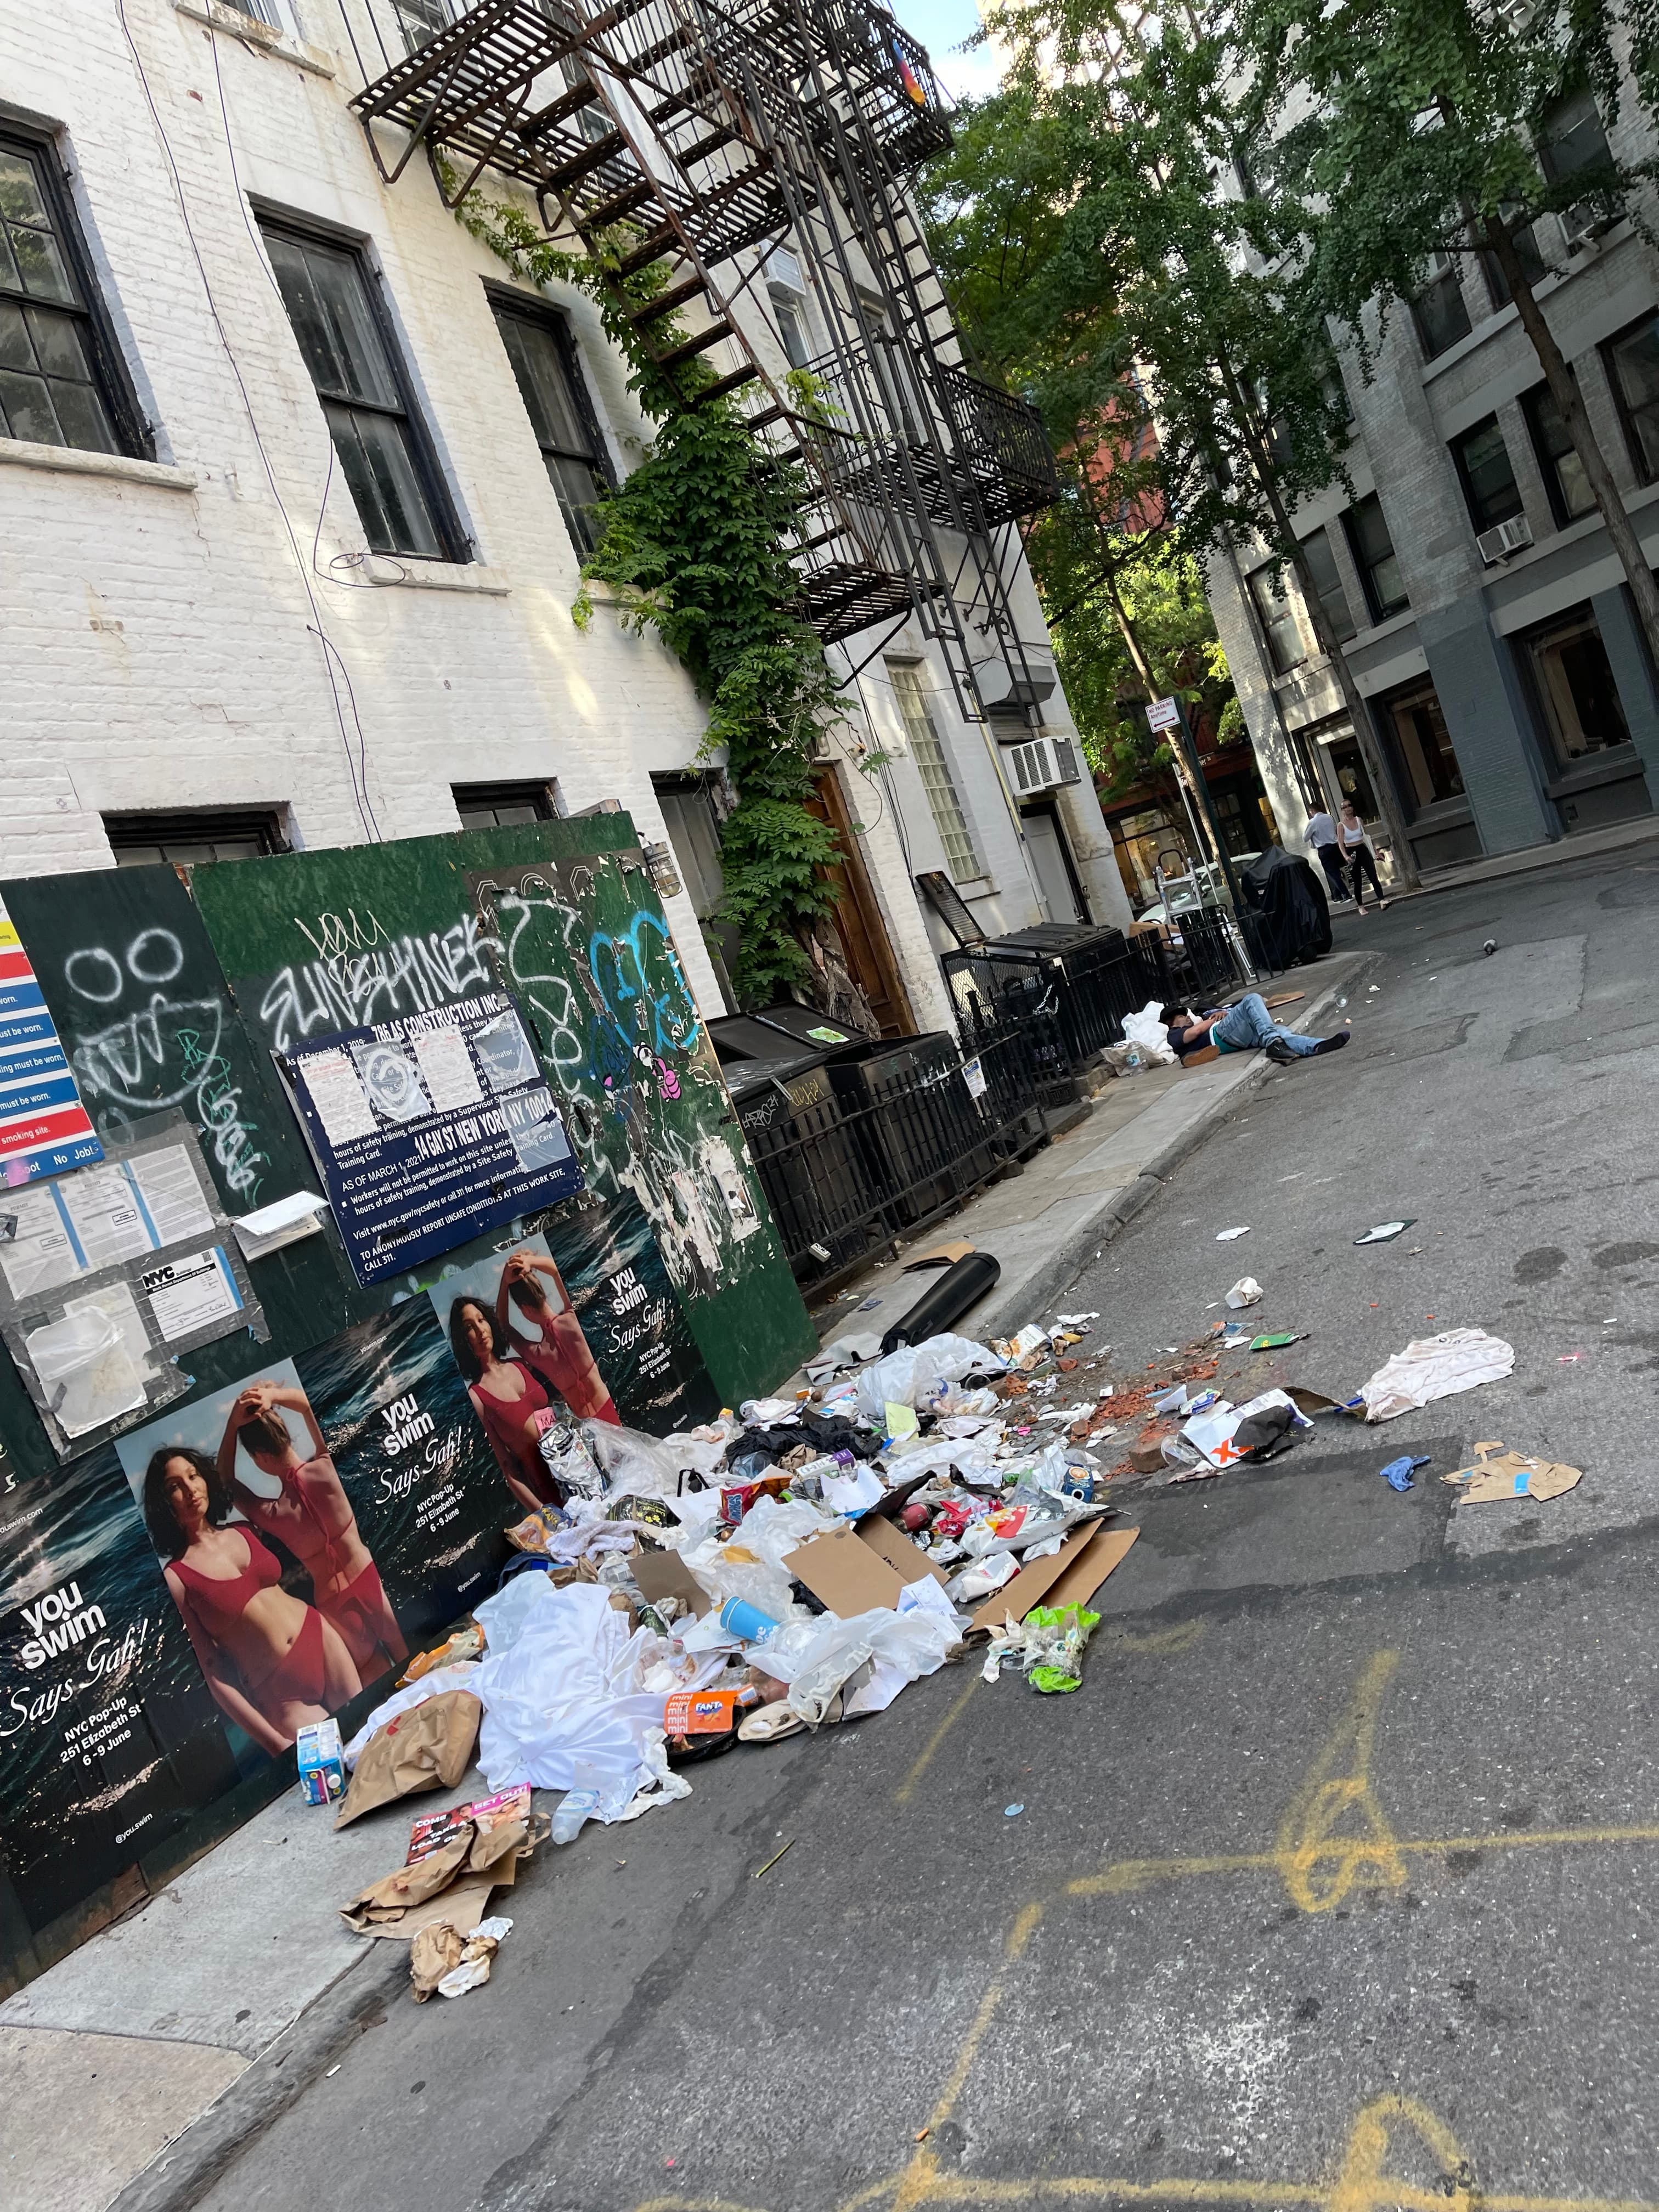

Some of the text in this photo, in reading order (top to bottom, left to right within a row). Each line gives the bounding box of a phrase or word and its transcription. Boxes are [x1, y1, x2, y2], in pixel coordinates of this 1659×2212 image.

[13, 1025, 22, 1035] be
[22, 1023, 44, 1034] worn.
[371, 1024, 392, 1043] 786
[390, 1019, 406, 1040] AS
[403, 997, 484, 1037] CONSTRUCTION
[460, 1019, 488, 1032] less they
[14, 1053, 64, 1071] must be worn.
[286, 1057, 295, 1067] As
[348, 1039, 366, 1051] 2019:
[480, 1077, 488, 1086] of
[20, 1096, 30, 1105] be
[30, 1092, 51, 1103] worn.
[1, 1126, 50, 1145] smoking site.
[333, 1147, 354, 1159] hours
[354, 1142, 362, 1153] of
[362, 1136, 382, 1149] safety
[382, 1128, 408, 1142] training,
[407, 1115, 444, 1134] demonstrated
[445, 1112, 453, 1121] by
[459, 1099, 494, 1116] Supervisor
[414, 1133, 429, 1161] 14
[425, 1128, 446, 1157] GAY
[442, 1124, 458, 1150] ST
[454, 1116, 482, 1147] NEW
[507, 1102, 525, 1127] NY
[525, 1090, 556, 1121] 10014
[53, 1145, 93, 1166] No Job!
[337, 1148, 382, 1170] Training Card.
[342, 1180, 354, 1192] AS
[355, 1174, 367, 1187] OF
[368, 1163, 398, 1182] MARCH
[405, 1154, 422, 1168] 2021
[351, 1188, 379, 1205] Workers
[379, 1181, 392, 1195] will
[392, 1178, 404, 1189] not
[403, 1174, 412, 1185] be
[411, 1165, 439, 1183] permitted
[438, 1162, 445, 1171] to
[445, 1157, 458, 1167] work
[459, 1154, 467, 1163] on
[466, 1147, 479, 1159] this
[480, 1142, 494, 1154] site
[354, 1204, 375, 1216] hours
[376, 1200, 383, 1208] of
[383, 1192, 403, 1205] safety
[403, 1182, 429, 1197] training,
[428, 1169, 464, 1187] demonstrated
[465, 1164, 472, 1173] by
[478, 1155, 492, 1167] Site
[492, 1147, 514, 1162] Safety
[353, 1226, 370, 1240] Visit
[370, 1199, 441, 1234] www.nyc.gov/nycsafety
[441, 1196, 447, 1205] or
[447, 1190, 458, 1202] call
[457, 1188, 465, 1198] 311
[465, 1184, 474, 1194] for
[474, 1179, 490, 1190] more
[360, 1249, 371, 1261] TO
[372, 1227, 422, 1257] ANONYMOUSLY
[422, 1217, 445, 1235] REPORT
[444, 1209, 467, 1224] UNSAFE
[503, 1188, 512, 1199] AT
[512, 1182, 529, 1196] THIS
[528, 1173, 549, 1188] WORK
[549, 1167, 566, 1181] SITE,
[364, 1252, 396, 1272] CALL 311.
[143, 1266, 175, 1288] NYC
[610, 1267, 637, 1296] you
[613, 1283, 648, 1316] swim
[608, 1296, 666, 1353] Says Gah!
[639, 1342, 665, 1363] NYC Pop-Up
[639, 1347, 672, 1375] 251 Elizabeth St
[661, 1361, 670, 1373] June
[381, 1392, 419, 1432] you
[384, 1412, 435, 1456] swim
[375, 1425, 462, 1504] Says Gah!
[415, 1489, 465, 1529] 251 Elizabeth St
[416, 1483, 455, 1514] NYC Pop-Up
[0, 1508, 43, 1534] ouswim.com
[444, 1508, 460, 1522] June
[20, 1581, 83, 1638] you
[21, 1605, 107, 1669] swim
[0, 1618, 149, 1737] Says Gah!
[64, 1696, 127, 1742] NYC Pop-Up
[668, 1716, 688, 1725] mini
[695, 1701, 723, 1712] FANTA
[60, 1703, 142, 1763] 251 Elizabeth St
[106, 1729, 132, 1751] June
[668, 1725, 688, 1734] mini
[474, 1785, 528, 1810] GET OUT!
[416, 1814, 447, 1829] COME
[430, 1822, 458, 1838] TAKE
[411, 1836, 441, 1852] LOAD
